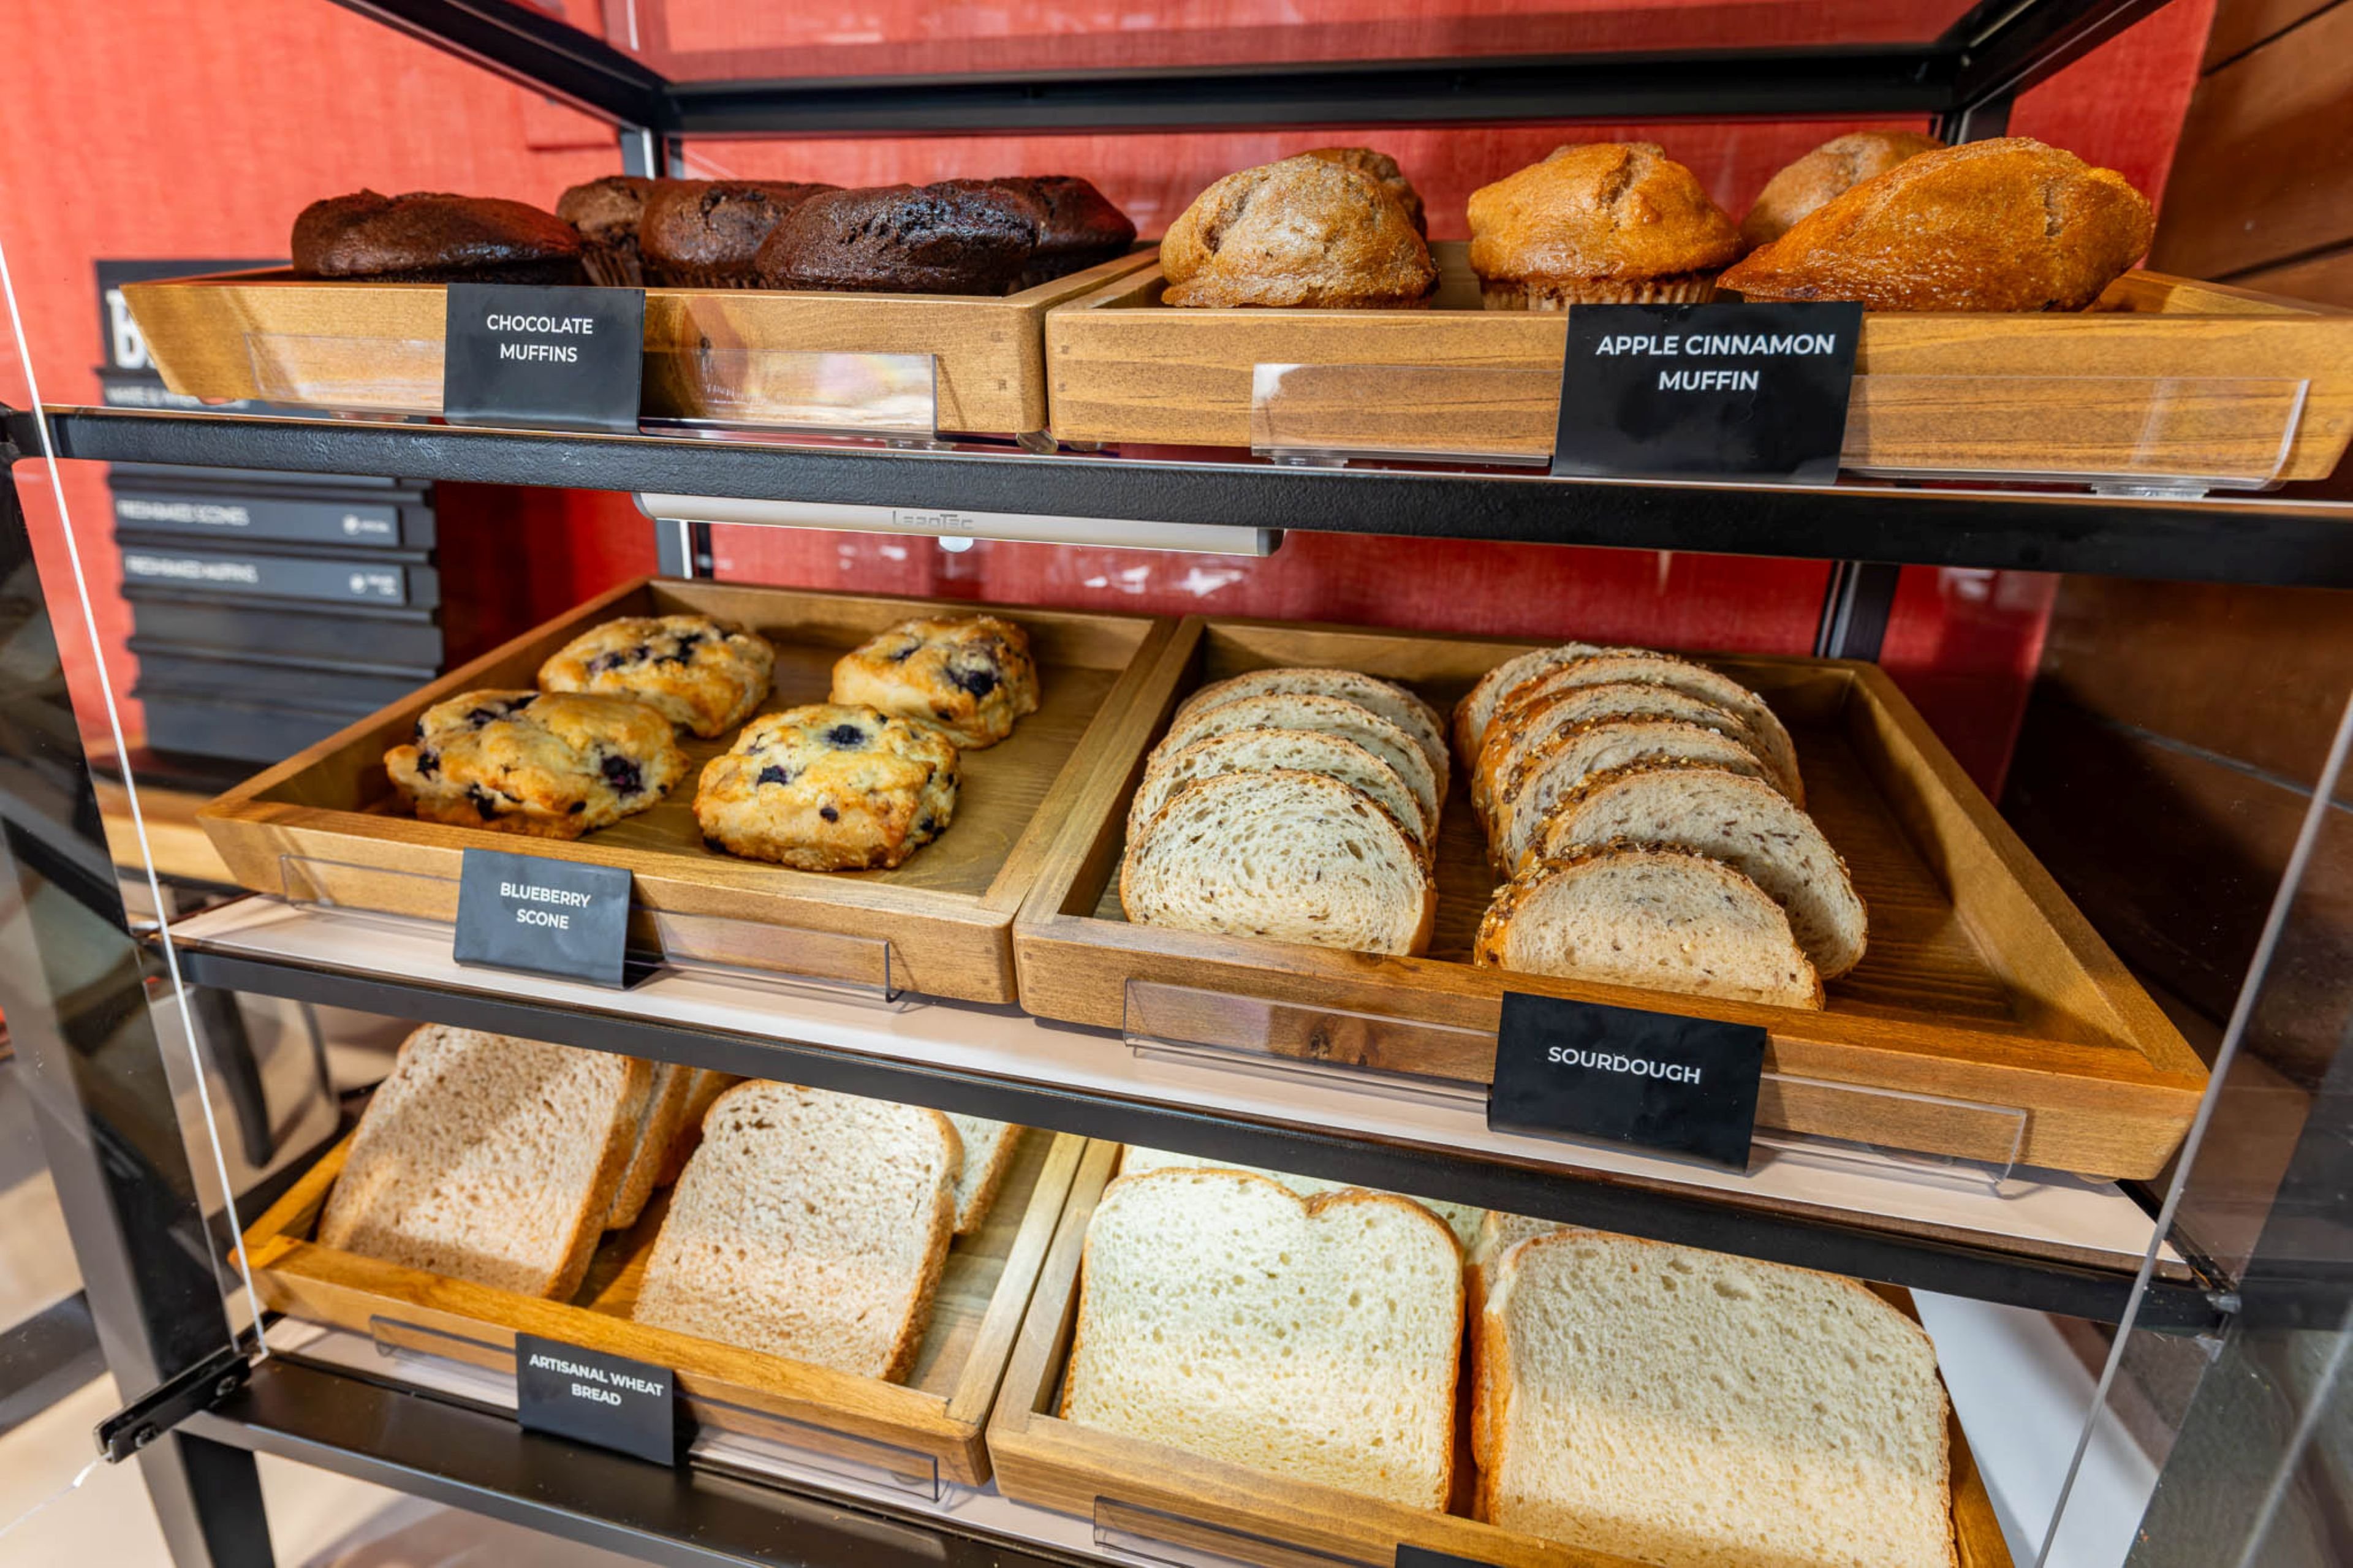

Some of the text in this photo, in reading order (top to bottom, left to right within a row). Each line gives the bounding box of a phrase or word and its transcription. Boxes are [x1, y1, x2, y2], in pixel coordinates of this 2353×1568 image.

[485, 313, 593, 335] CHOCOLATE
[499, 343, 577, 362] MUFFINS
[1595, 334, 1835, 356] APPLE CINNAMON
[1659, 370, 1759, 391] MUFFIN
[500, 882, 591, 907] BLUEBERRY
[517, 909, 569, 930] SCONE
[1547, 1046, 1701, 1085] SOURDOUGH
[529, 1354, 664, 1396] ARTISANAL WHEAT
[571, 1383, 621, 1406] BREAD
